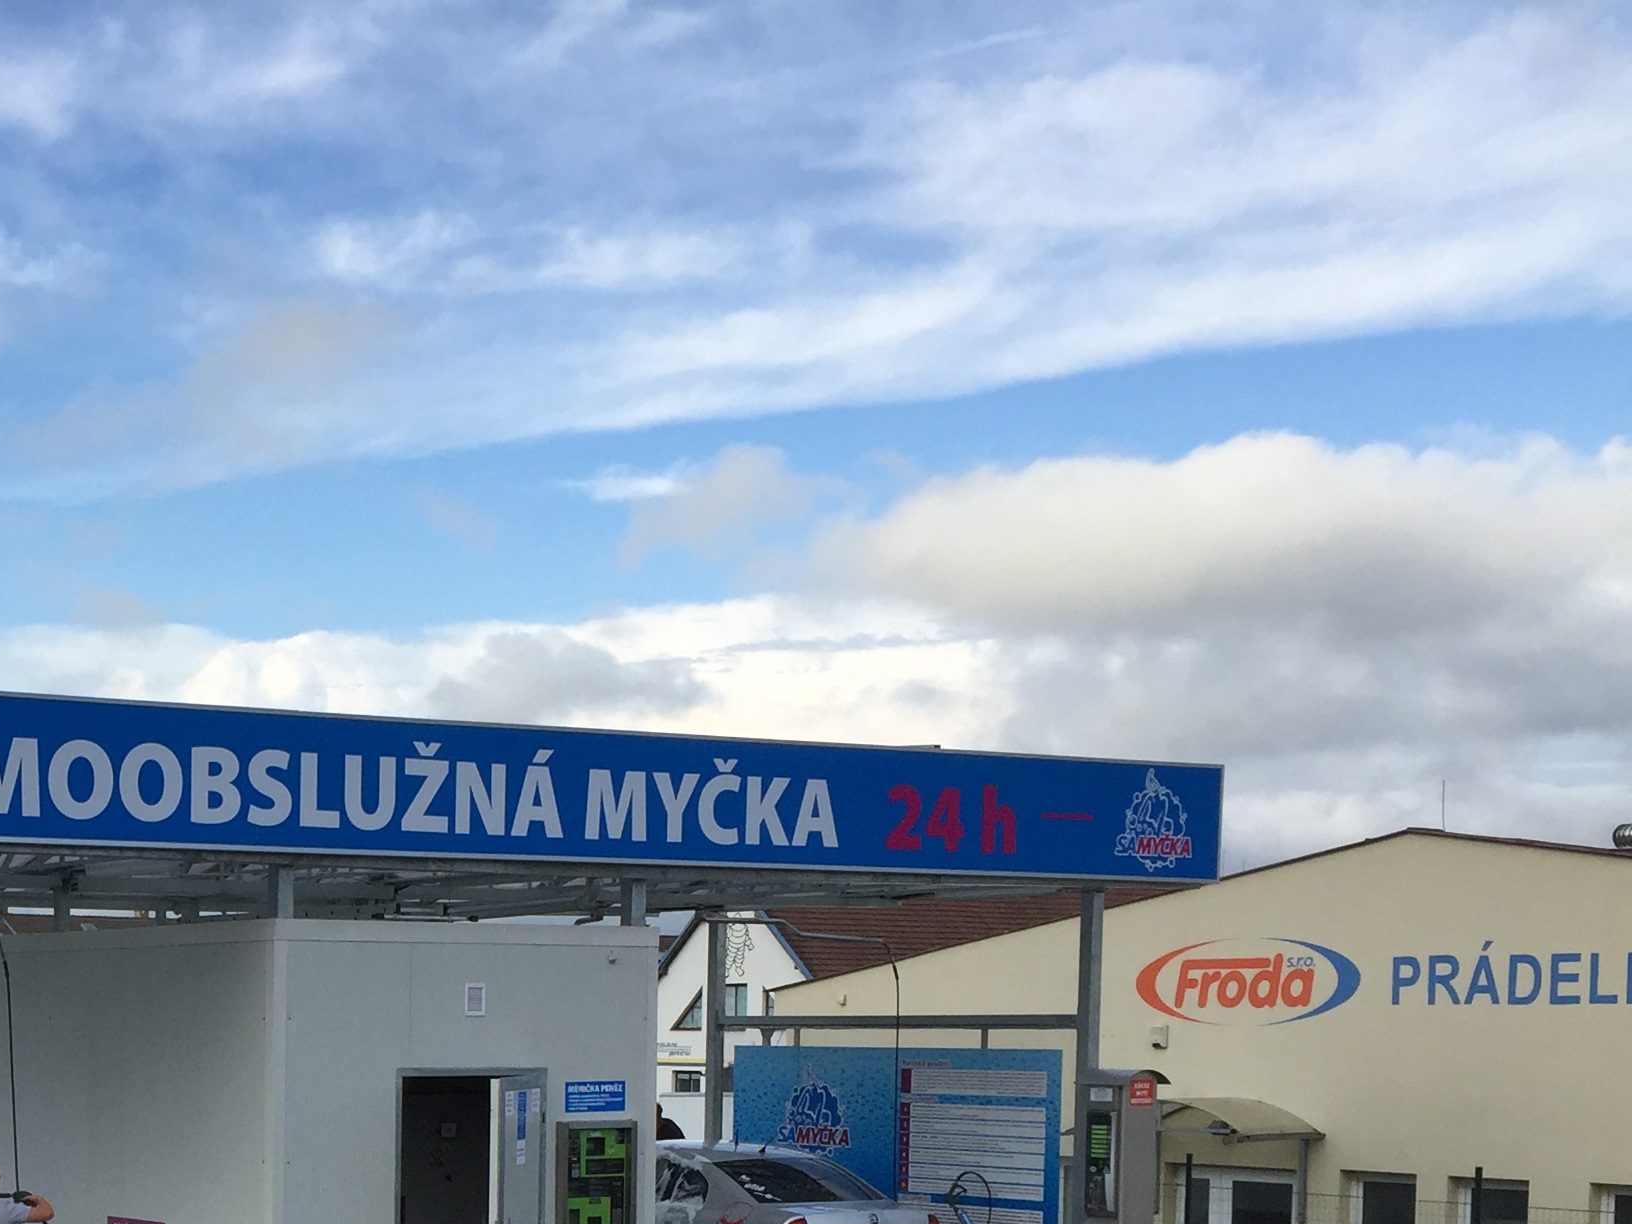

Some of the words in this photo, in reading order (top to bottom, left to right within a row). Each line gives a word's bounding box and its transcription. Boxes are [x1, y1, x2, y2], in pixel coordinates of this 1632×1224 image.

[584, 757, 839, 848] MYČKA
[885, 784, 964, 852] 24
[980, 784, 1017, 854] h
[1114, 831, 1192, 858] SAMYČKA
[1174, 952, 1315, 1009] Froda
[1286, 956, 1316, 968] s.r.o.
[1391, 940, 1632, 1006] PRÁDEL
[777, 1123, 851, 1148] SAMYČKA
